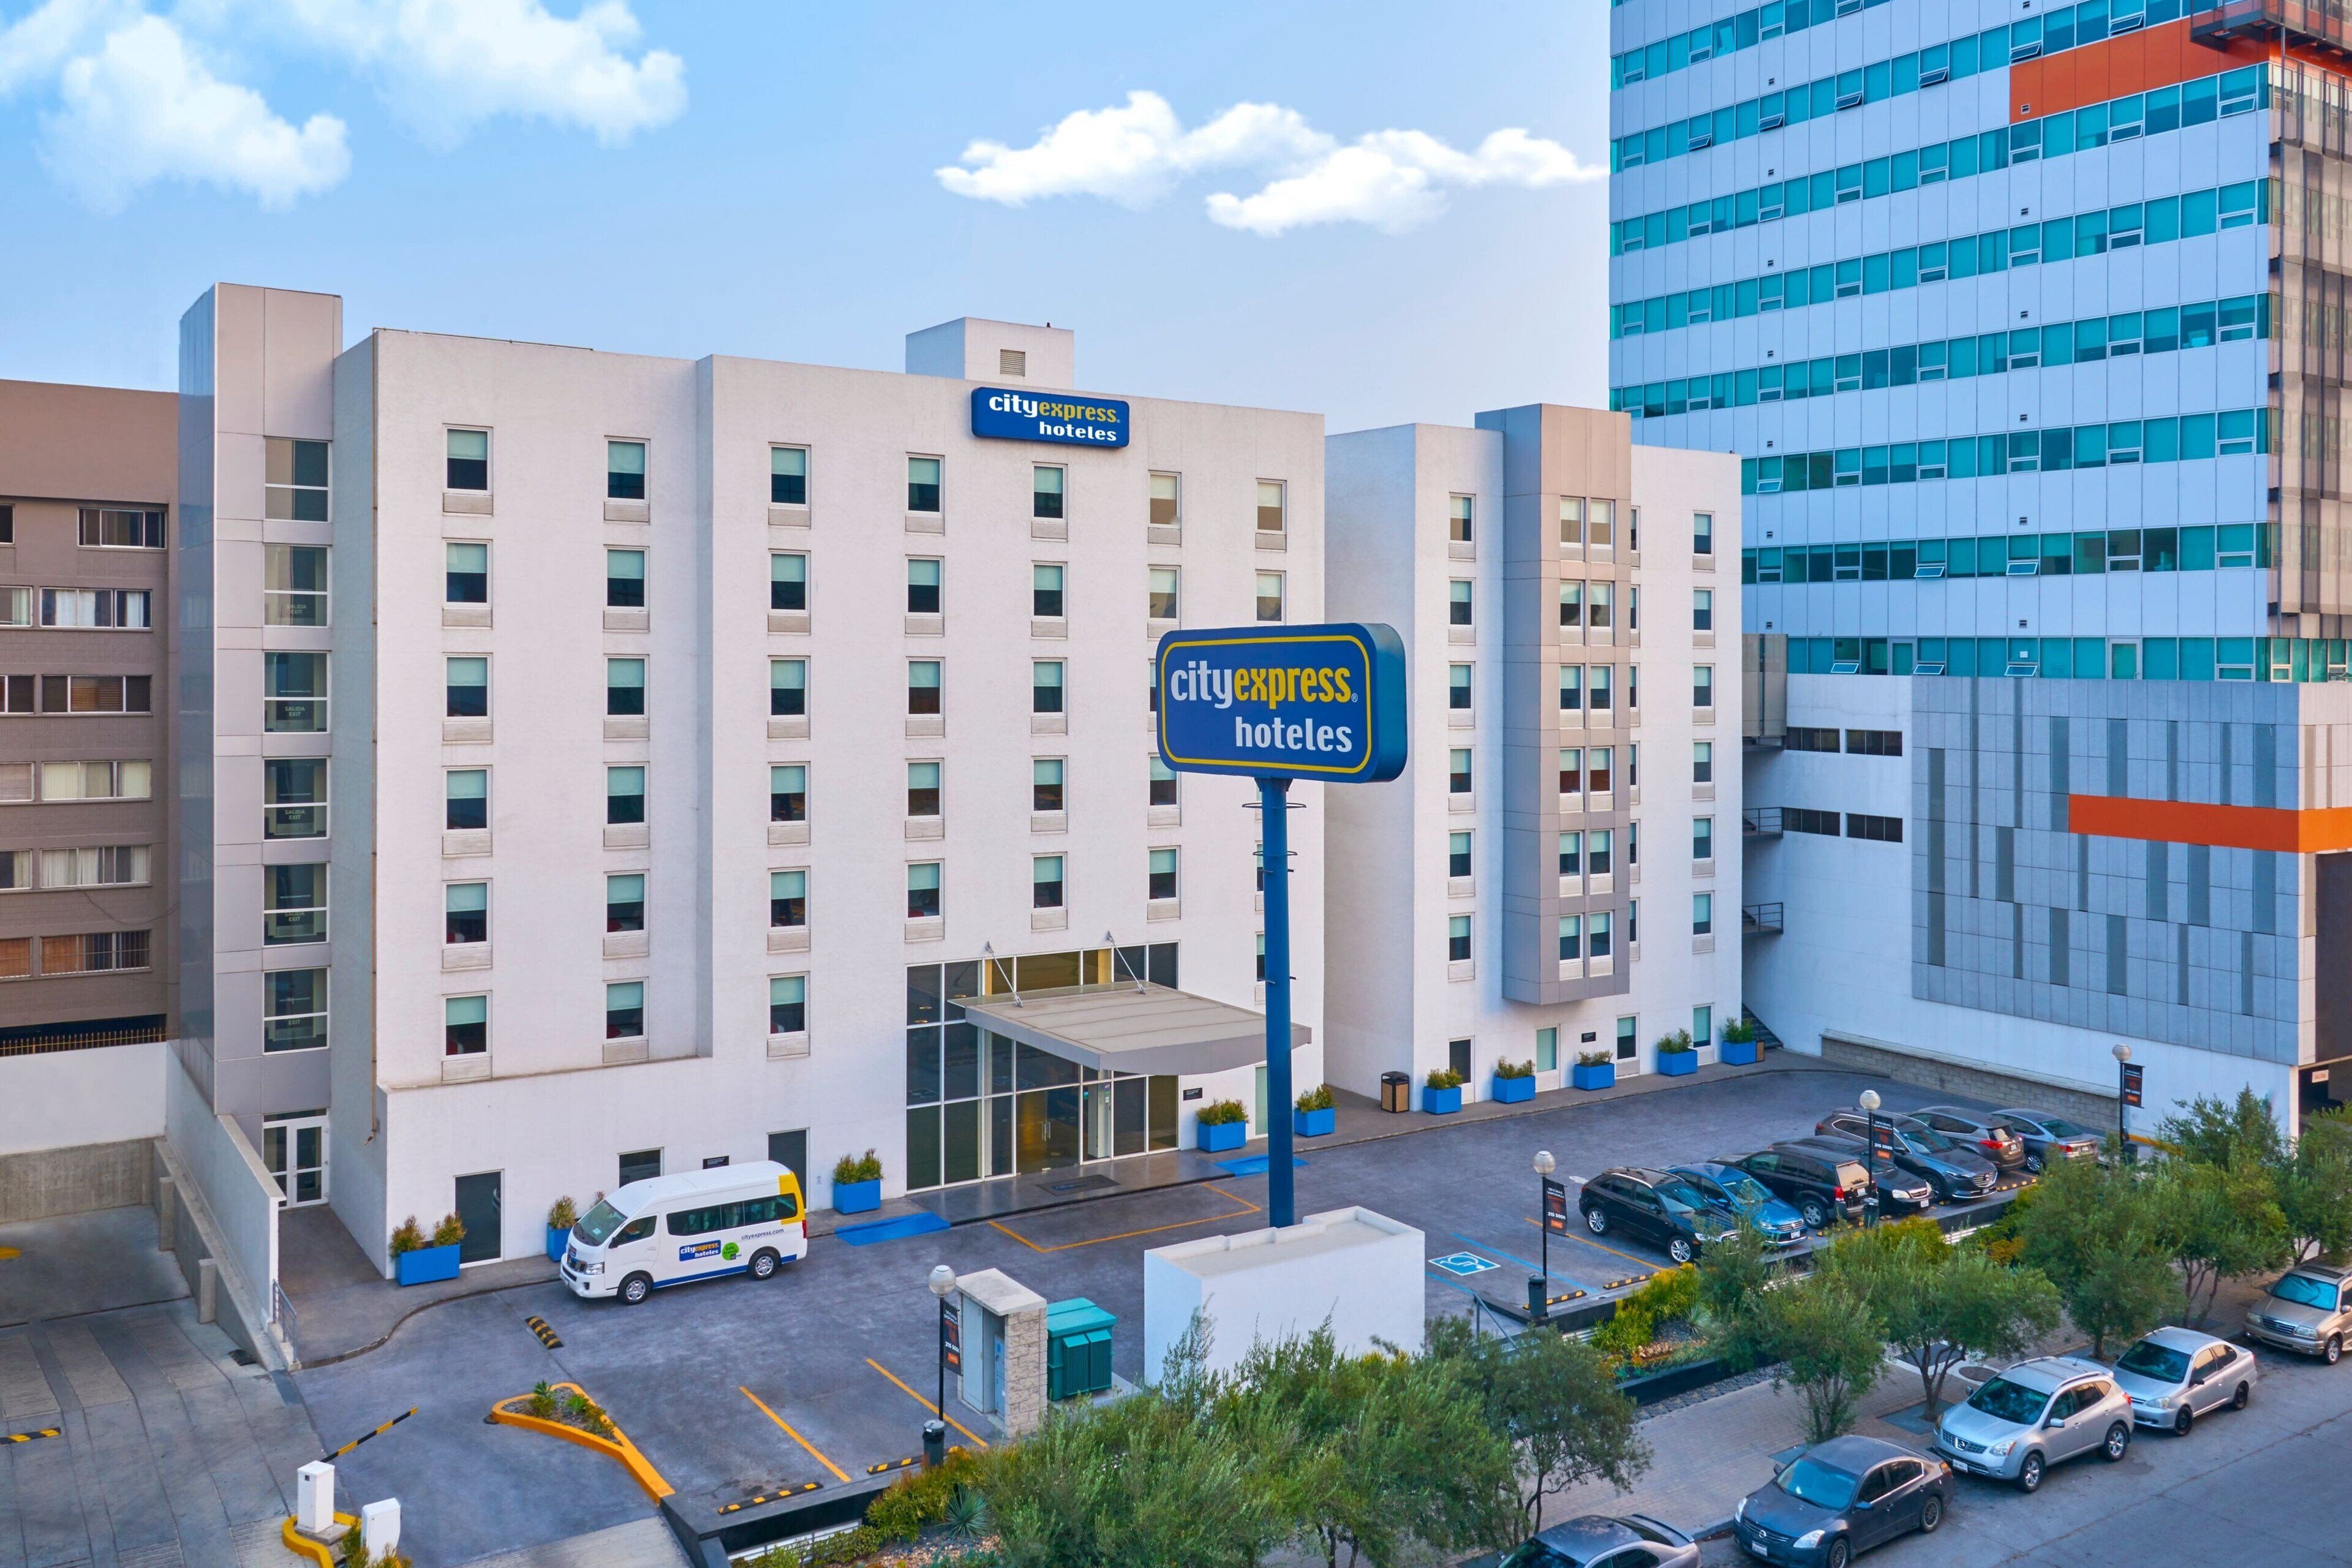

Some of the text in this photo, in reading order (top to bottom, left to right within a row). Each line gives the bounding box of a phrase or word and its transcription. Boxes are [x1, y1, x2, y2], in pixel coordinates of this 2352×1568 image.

[1039, 421, 1117, 442] hoteles
[1235, 716, 1352, 753] hoteles
[741, 1229, 784, 1240] cityexpress.com
[695, 1249, 719, 1258] hoteles
